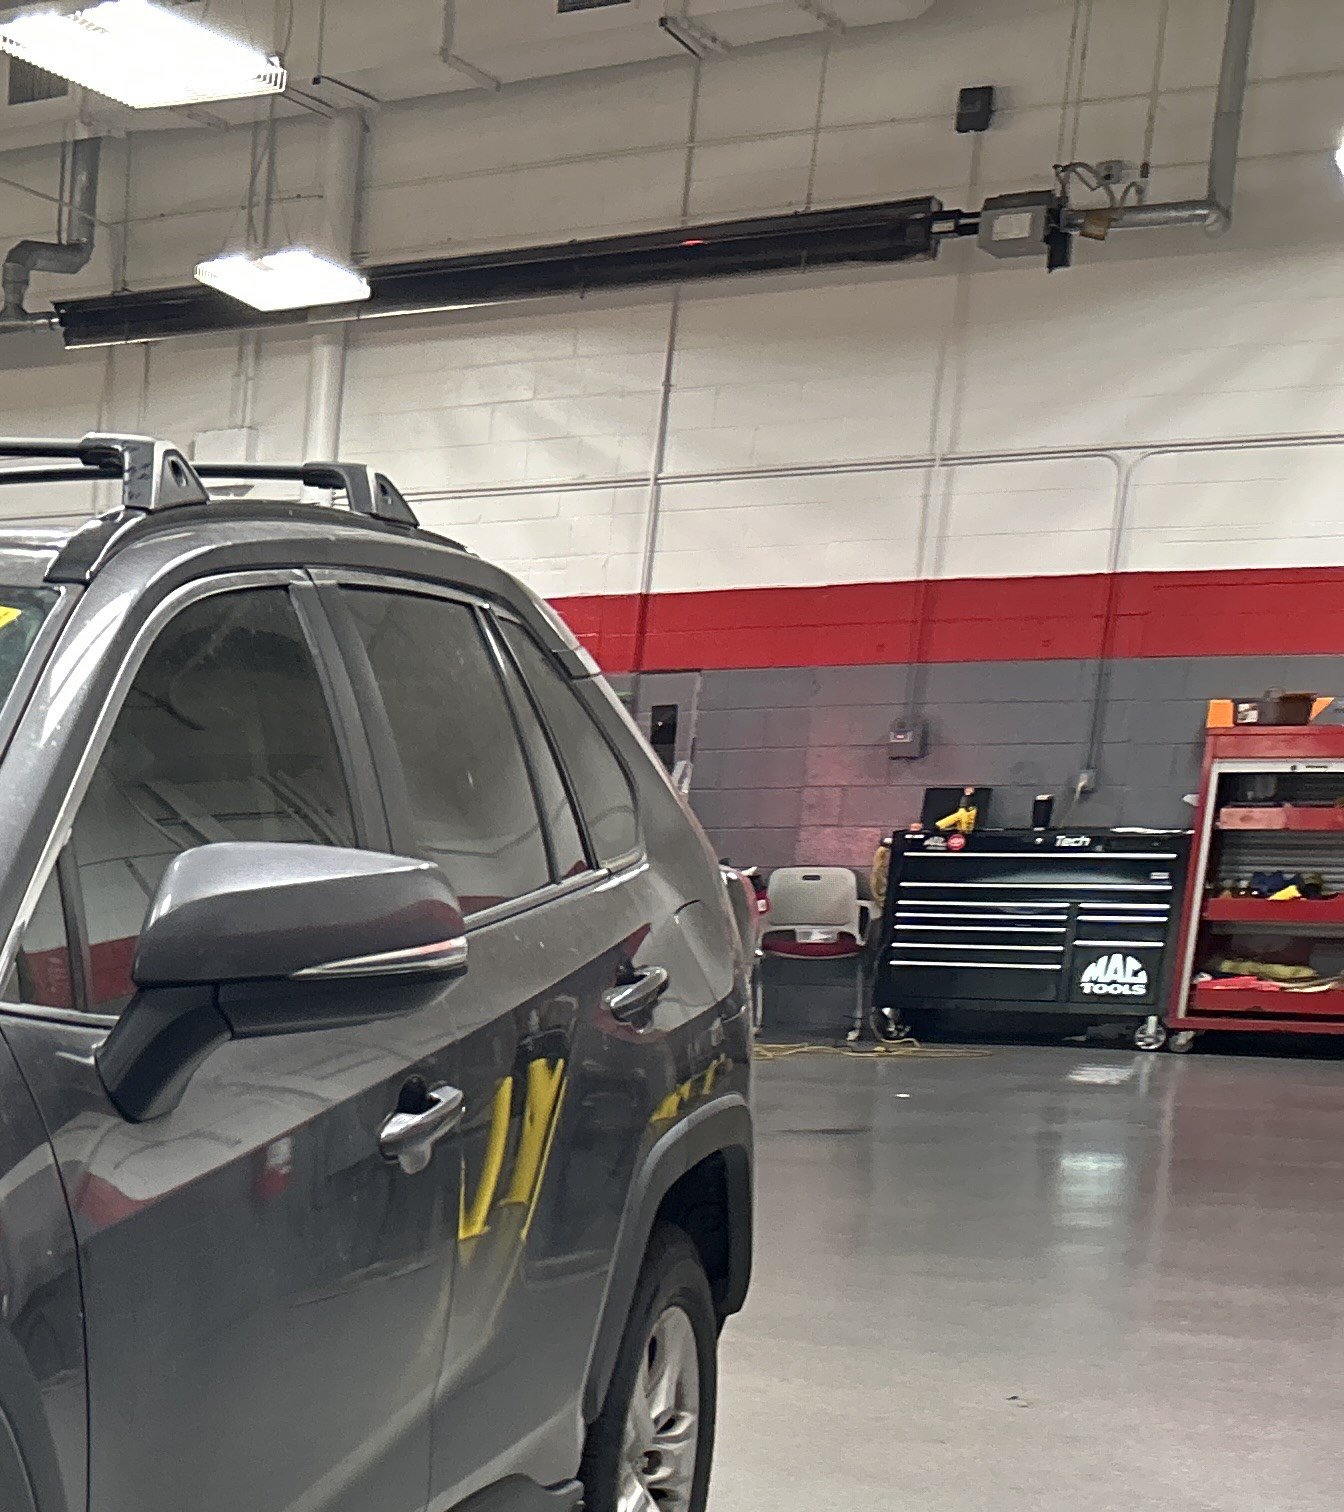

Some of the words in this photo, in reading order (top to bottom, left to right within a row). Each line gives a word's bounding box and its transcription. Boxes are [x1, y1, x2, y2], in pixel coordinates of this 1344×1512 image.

[1055, 835, 1091, 847] Tech
[1080, 953, 1148, 983] MAC
[1079, 982, 1147, 995] TOOLS
